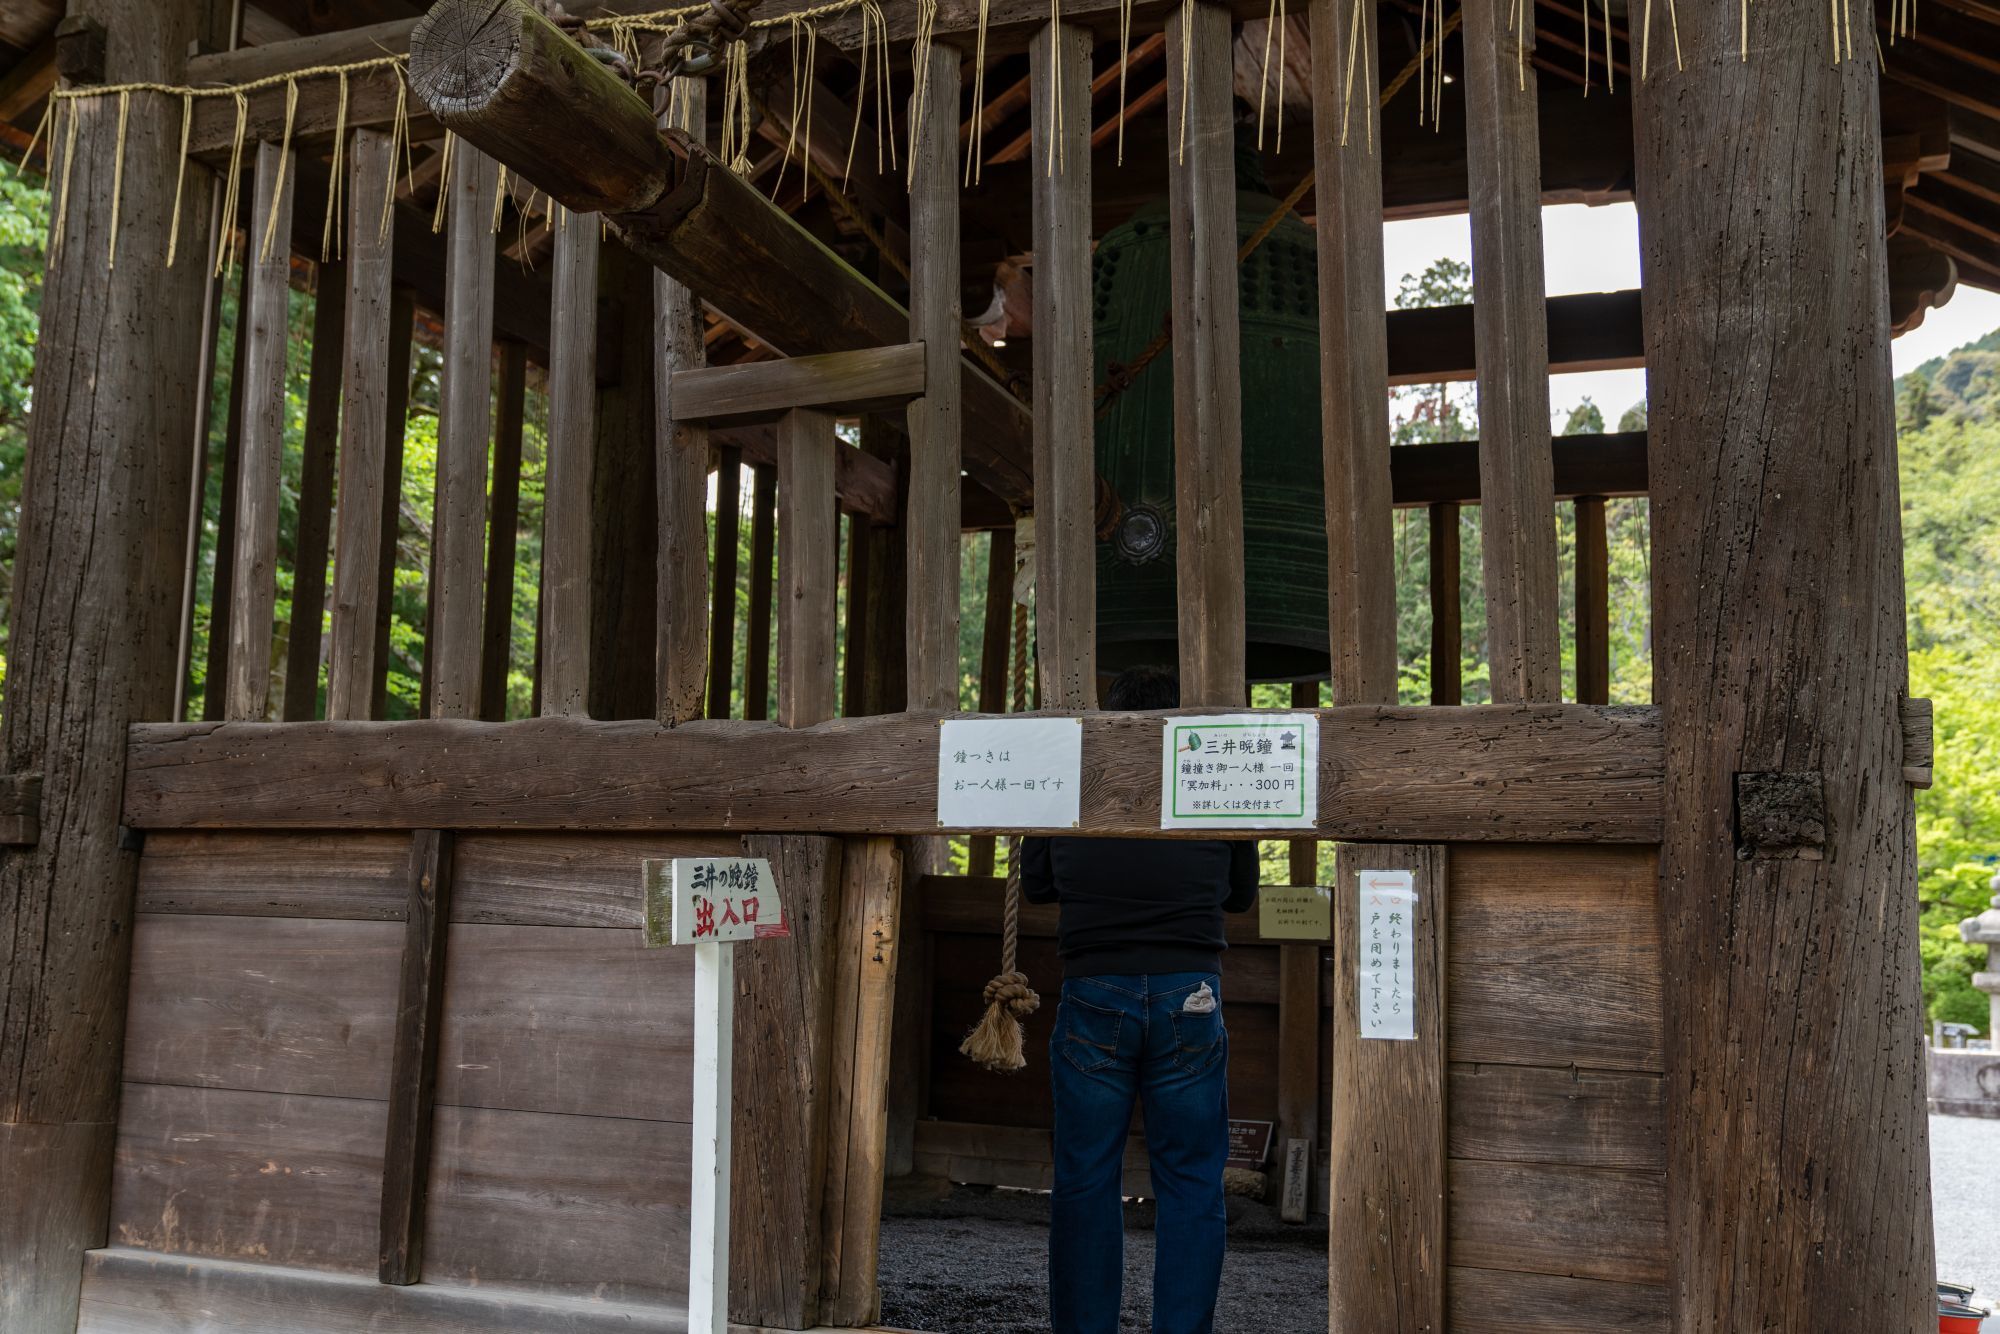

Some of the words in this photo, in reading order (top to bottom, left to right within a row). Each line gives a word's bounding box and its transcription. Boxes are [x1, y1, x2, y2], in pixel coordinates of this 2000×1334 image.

[953, 749, 1011, 764] 鐘つきは
[1204, 738, 1273, 755] 三井晩鐘
[953, 777, 1064, 791] お一人様一回です
[1192, 800, 1283, 810] ※詳しくは受付まで
[690, 861, 760, 896] 三井の晩鐘
[695, 896, 760, 937] 出入口
[1370, 912, 1382, 1028] 戸を閉めて下さい
[1389, 912, 1402, 1015] 終わりましたら
